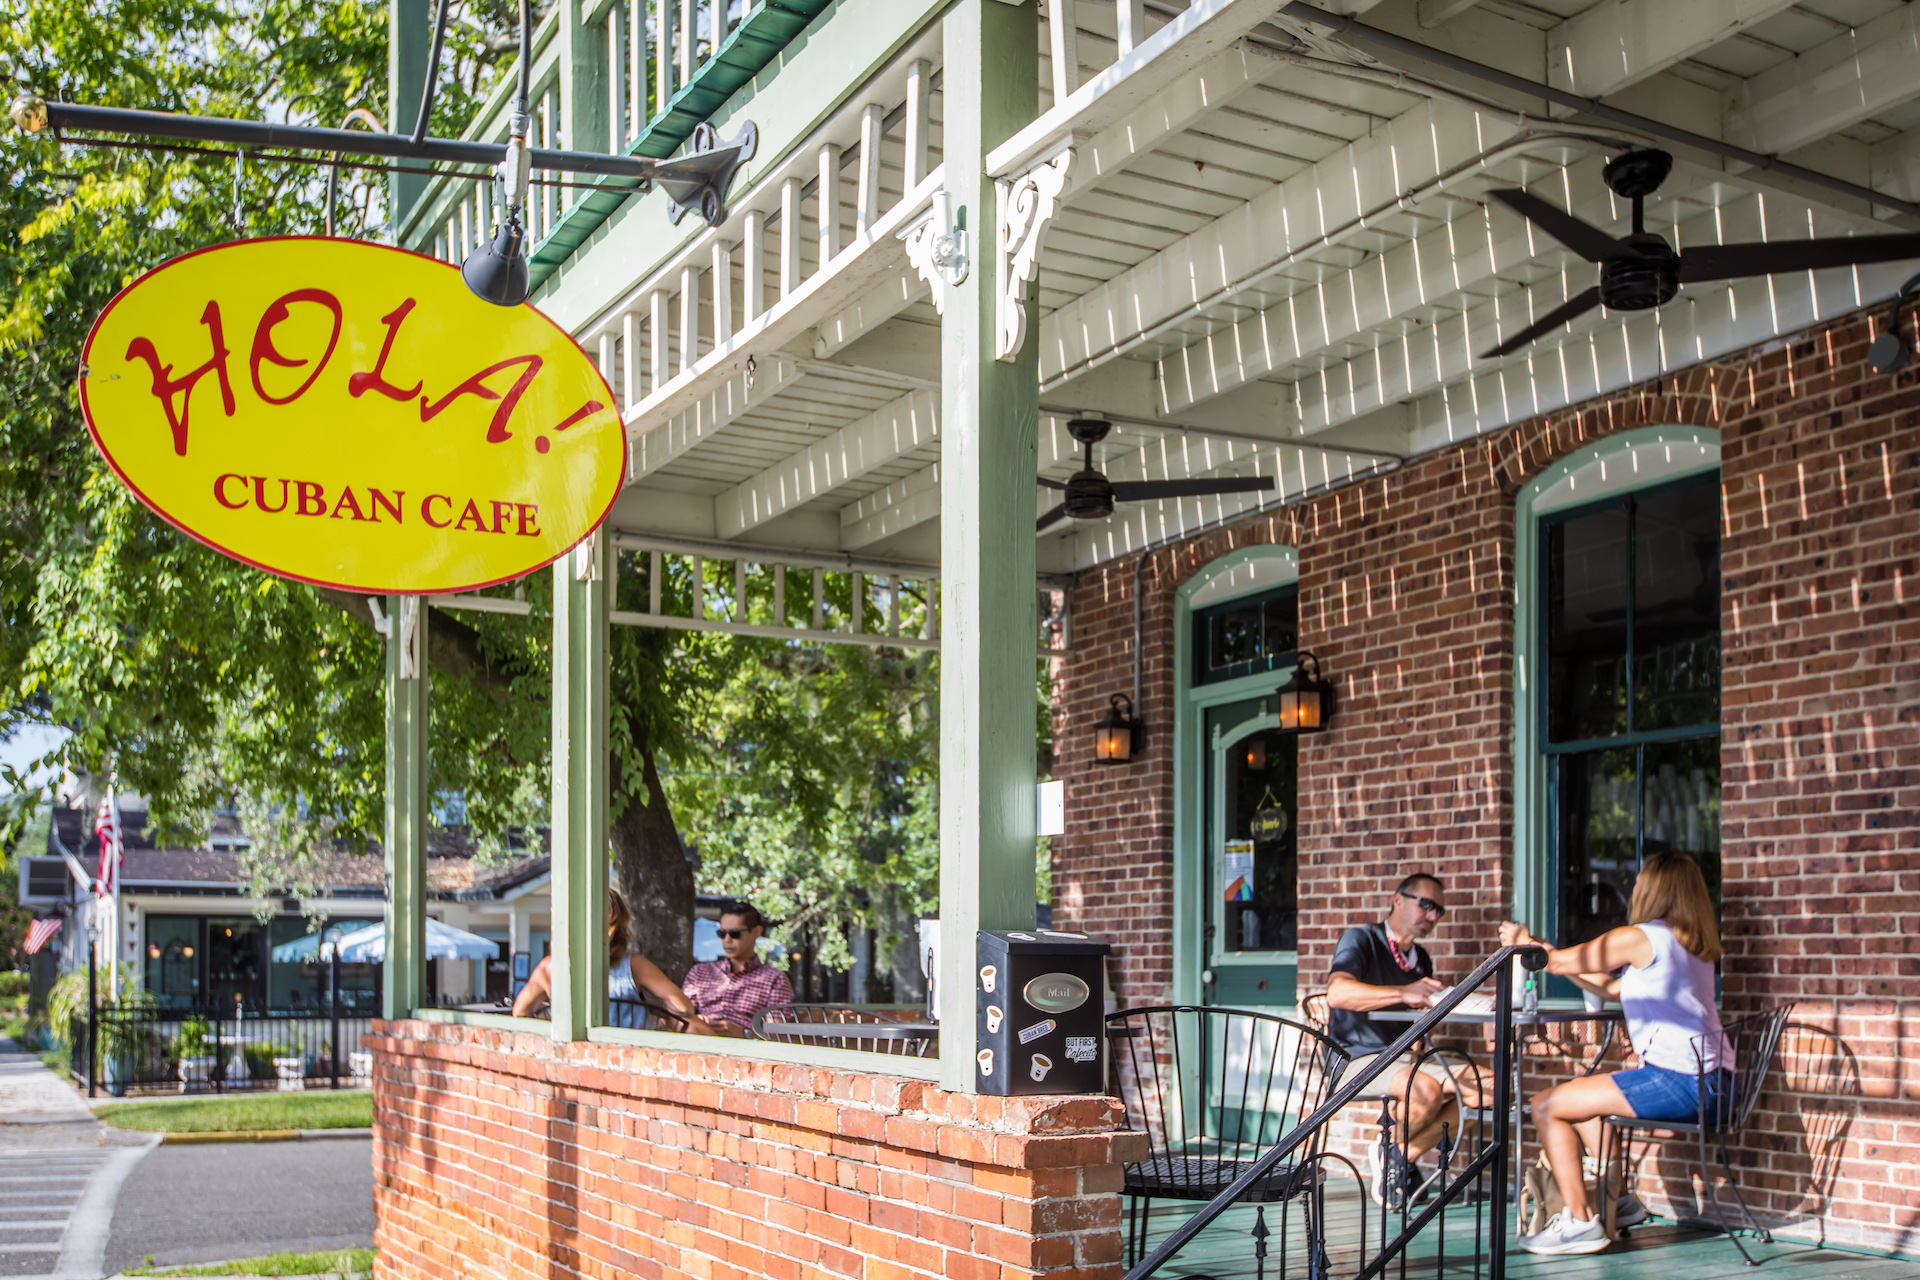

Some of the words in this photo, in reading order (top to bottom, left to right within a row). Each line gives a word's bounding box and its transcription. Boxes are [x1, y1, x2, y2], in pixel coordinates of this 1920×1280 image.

[125, 288, 605, 457] HOLA!
[213, 473, 406, 525] CUBAN
[420, 494, 541, 538] CAFE
[1047, 987, 1070, 998] Mail
[1023, 1029, 1038, 1040] CUBAN
[1066, 1038, 1078, 1046] BUT
[1066, 1047, 1096, 1061] Cafecito
